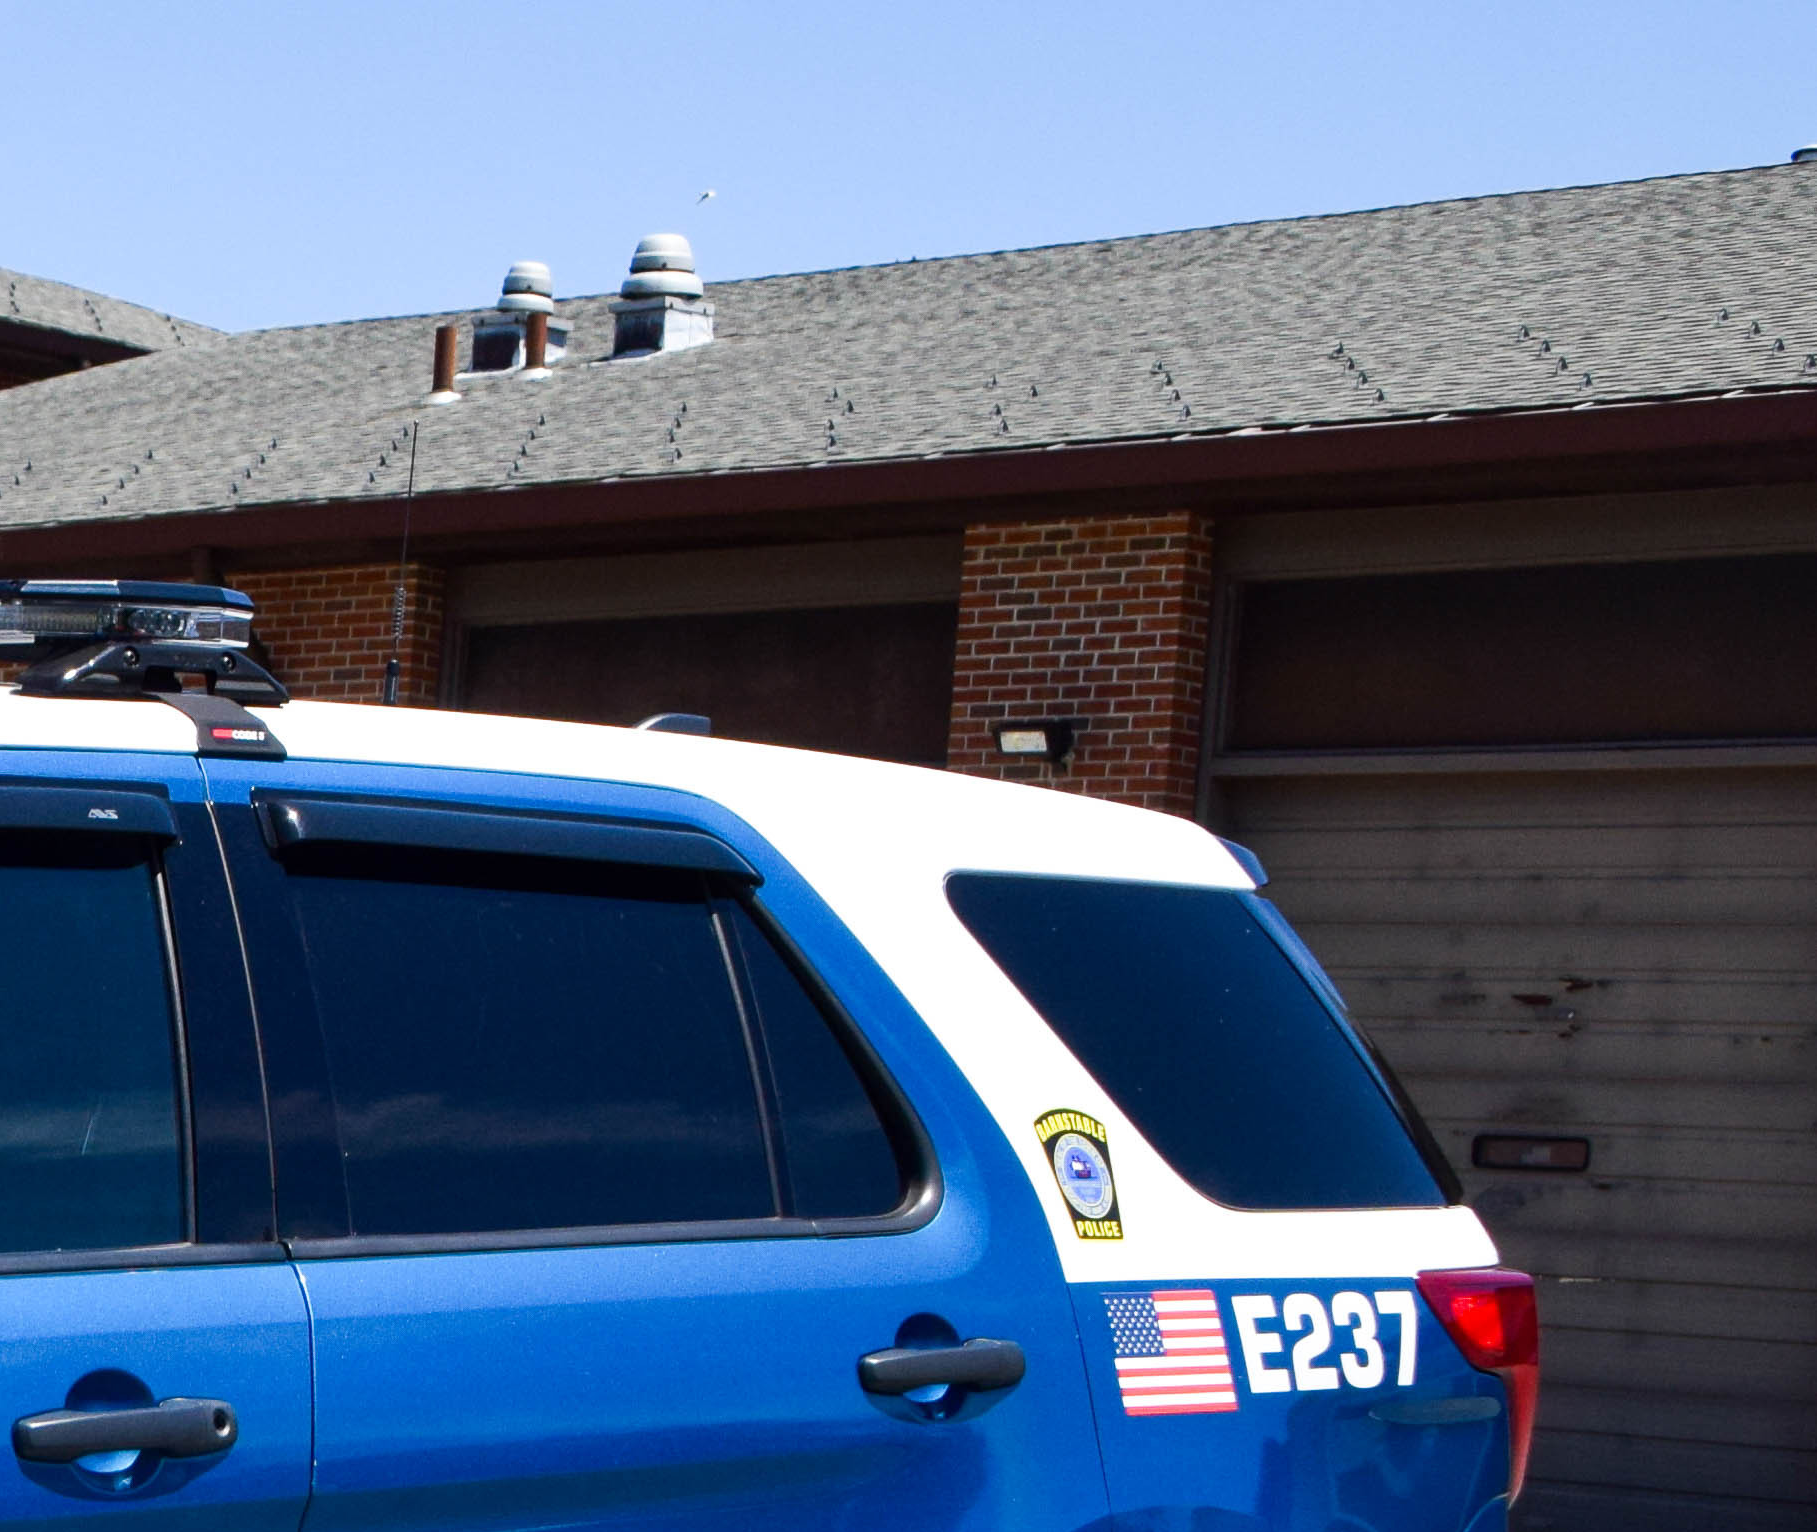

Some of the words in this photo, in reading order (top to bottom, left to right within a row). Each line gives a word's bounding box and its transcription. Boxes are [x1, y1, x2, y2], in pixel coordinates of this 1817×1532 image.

[1035, 1112, 1107, 1143] BARNSTABLE
[1076, 1220, 1121, 1237] POLICE
[1231, 1290, 1418, 1394] E237
